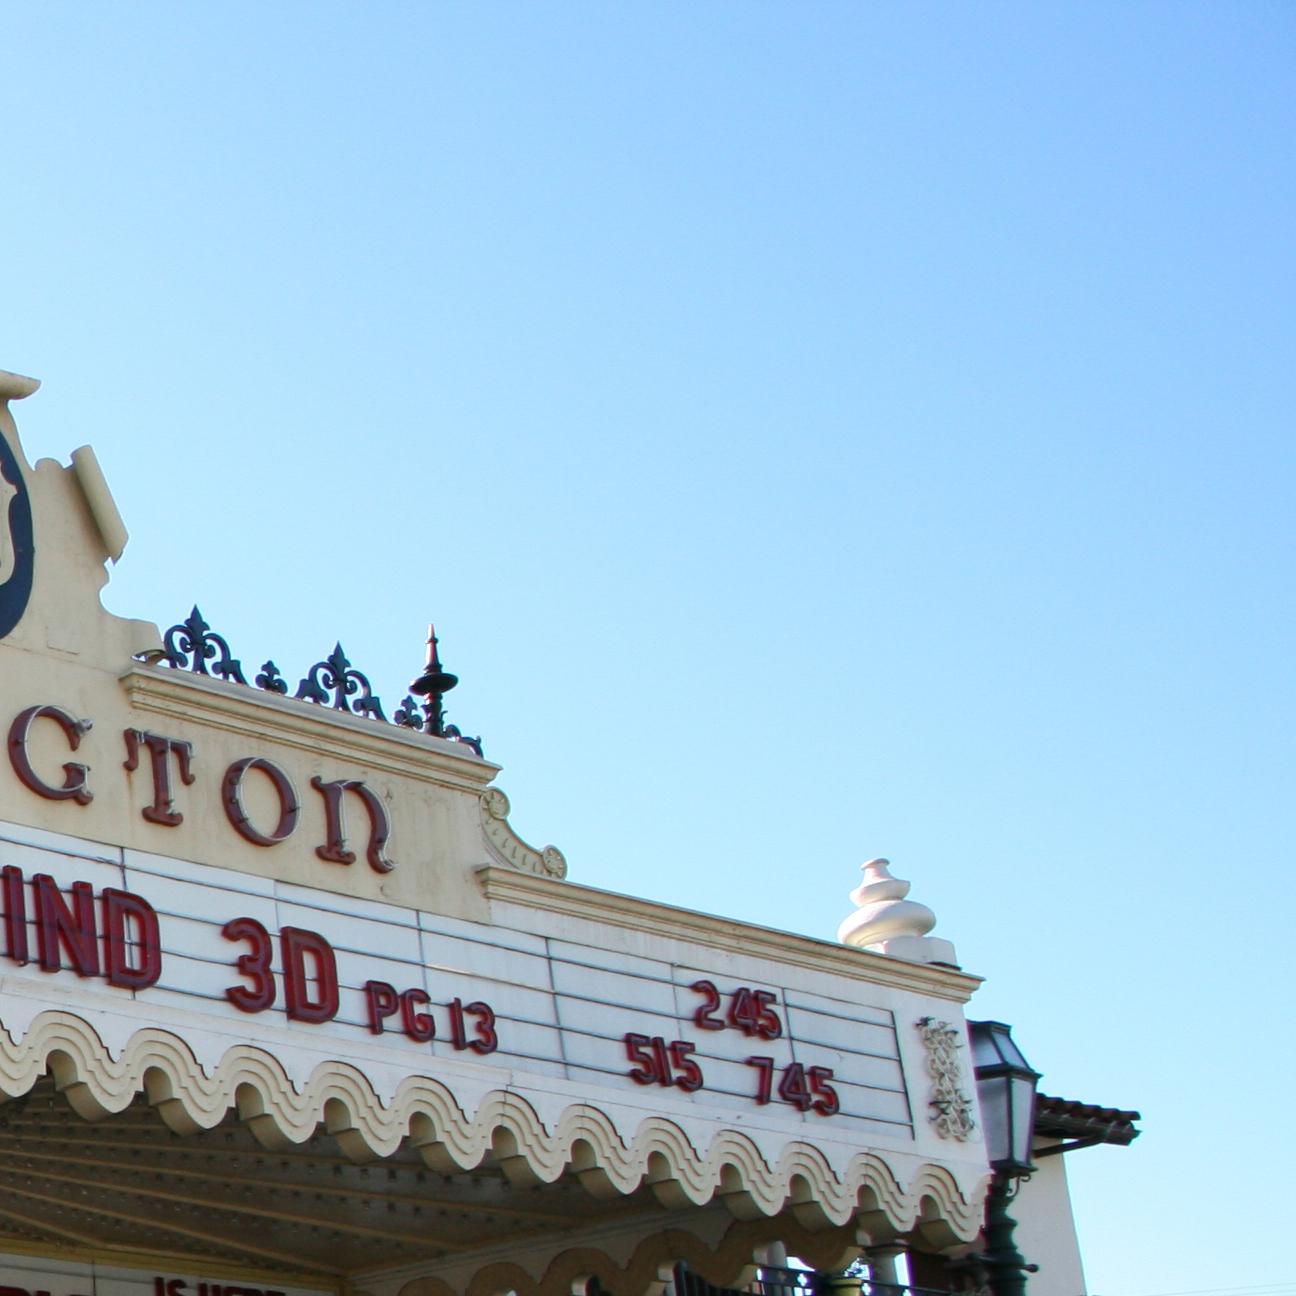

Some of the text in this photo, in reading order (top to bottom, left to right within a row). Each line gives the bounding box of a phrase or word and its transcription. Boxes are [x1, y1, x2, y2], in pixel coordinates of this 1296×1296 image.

[221, 917, 339, 1024] 3D
[688, 979, 782, 1040] 245
[623, 1032, 840, 1116] 515 745
